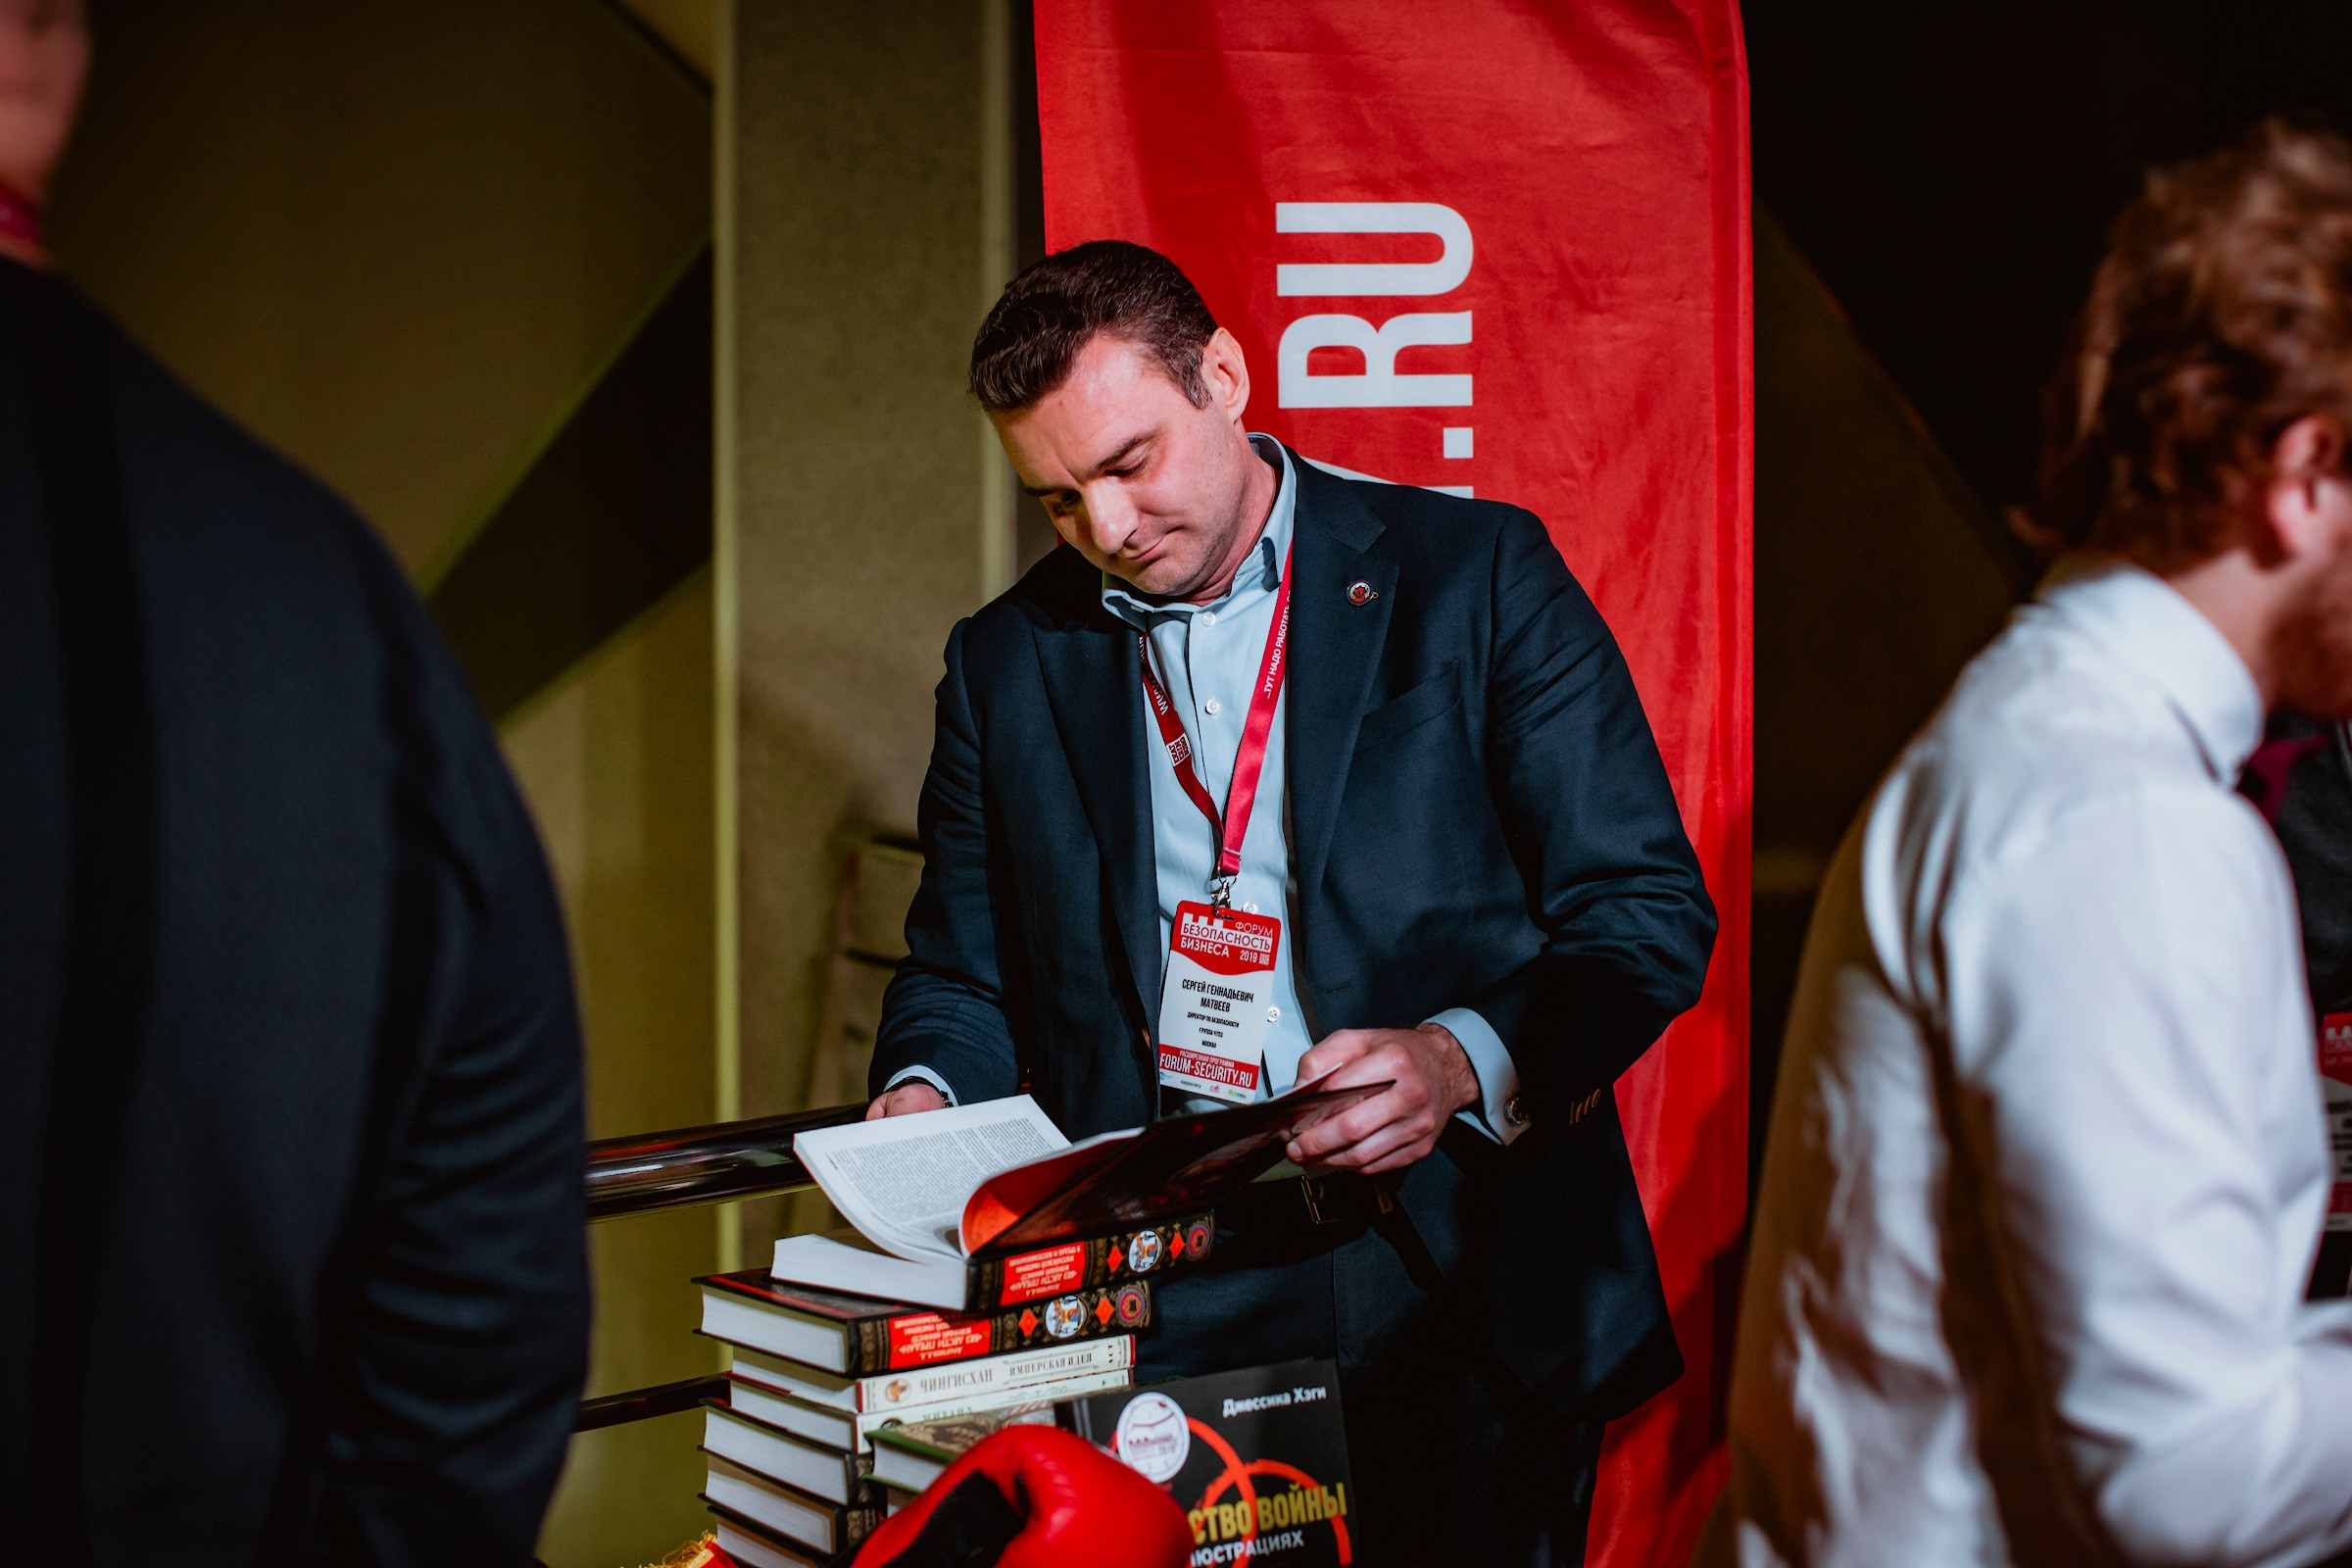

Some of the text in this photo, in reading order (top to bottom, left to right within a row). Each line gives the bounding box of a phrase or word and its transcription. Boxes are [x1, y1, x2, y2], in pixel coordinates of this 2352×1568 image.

[1276, 202, 1474, 499] .RU
[1268, 649, 1282, 675] НАДО
[1183, 923, 1270, 951] БЕЗОПАСНОСТЬ
[1235, 921, 1273, 937] ФОРУМ
[1180, 936, 1230, 957] БИЗНЕСА
[1240, 950, 1257, 963] 2019
[1182, 978, 1254, 1003] СЕРГЕЙ ГЕННАДЬЕВИЧ
[1200, 997, 1231, 1012] МАТВЕЕВ
[1187, 1011, 1205, 1020] ДИРЕКТОР
[1211, 1016, 1240, 1028] БЕЗОПАСНОСТИ
[1201, 1040, 1217, 1049] МОСКВА
[1159, 1053, 1252, 1088] FORUM-SECURITY.RU
[920, 1352, 1092, 1393] ЧИНГИСХАН ИМПЕРСКАЯ ИДЕЯ
[1222, 1386, 1327, 1418] Джессика Хэги
[1188, 1482, 1348, 1545] СТВО ВОЙНЫ
